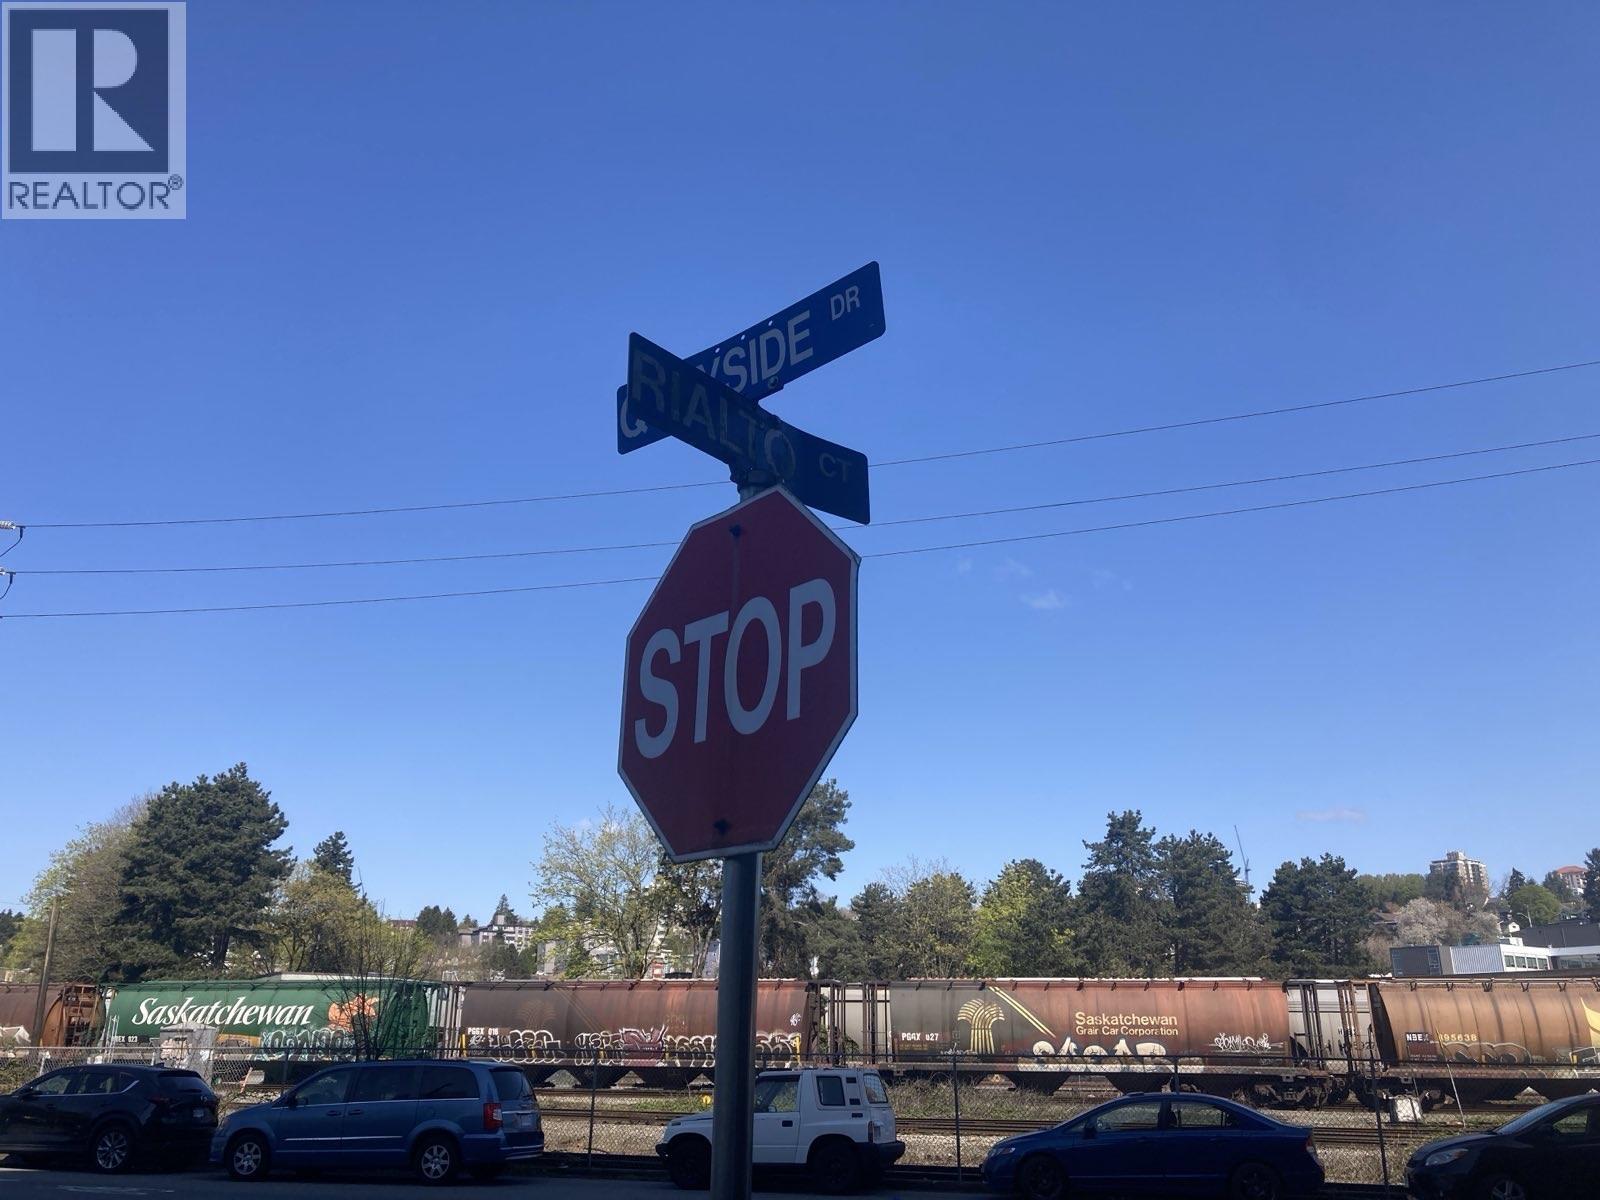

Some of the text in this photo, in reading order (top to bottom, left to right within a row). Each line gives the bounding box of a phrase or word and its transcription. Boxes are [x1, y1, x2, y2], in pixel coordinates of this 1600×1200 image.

[830, 284, 861, 321] DR
[630, 350, 851, 484] RIALTO CT
[634, 578, 836, 759] STOP
[131, 996, 315, 1027] Saskatchewan
[1075, 1011, 1178, 1026] Saskatchewan
[1102, 1026, 1119, 1036] Car
[1120, 1026, 1179, 1037] Corporation
